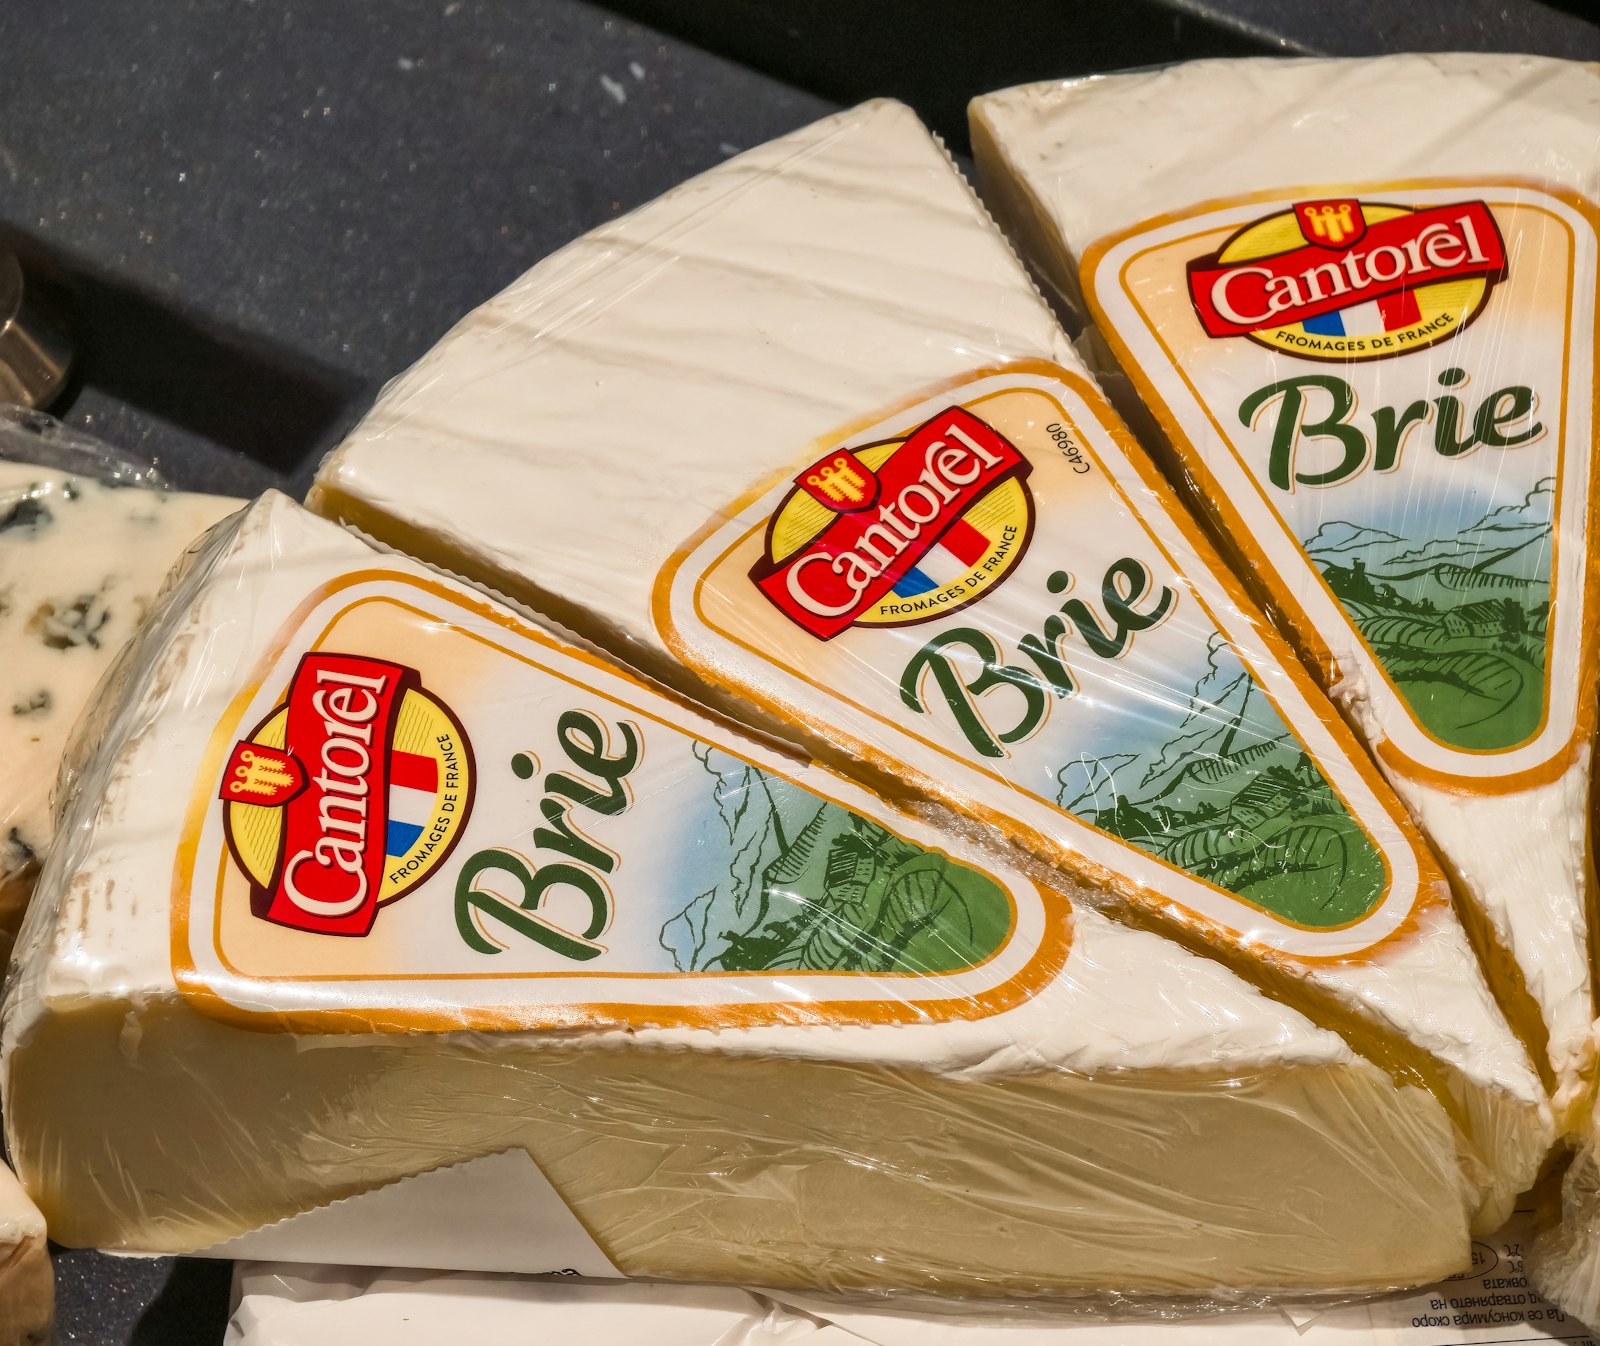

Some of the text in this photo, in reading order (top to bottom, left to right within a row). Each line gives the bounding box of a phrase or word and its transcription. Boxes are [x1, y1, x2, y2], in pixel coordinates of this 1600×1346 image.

[1211, 215, 1490, 326] Cantorel
[1276, 312, 1454, 351] FROMAGES DE FRANCE
[1046, 423, 1090, 474] C46980
[1238, 367, 1548, 494] Brie
[785, 423, 1003, 617] Cantorel
[880, 525, 1018, 615] FROMAGES DE FRANCE
[899, 557, 1178, 758] Brie
[284, 669, 387, 918] Cantorel
[389, 733, 459, 884] FROMAGES DE FRANCE
[454, 708, 645, 961] Brie
[1430, 1298, 1448, 1310] на
[1450, 1292, 1526, 1309] отварянето
[1453, 1309, 1525, 1325] консумира
[1483, 1277, 1528, 1290] овката
[1528, 1310, 1543, 1320] се
[1412, 1313, 1450, 1328] скоро
